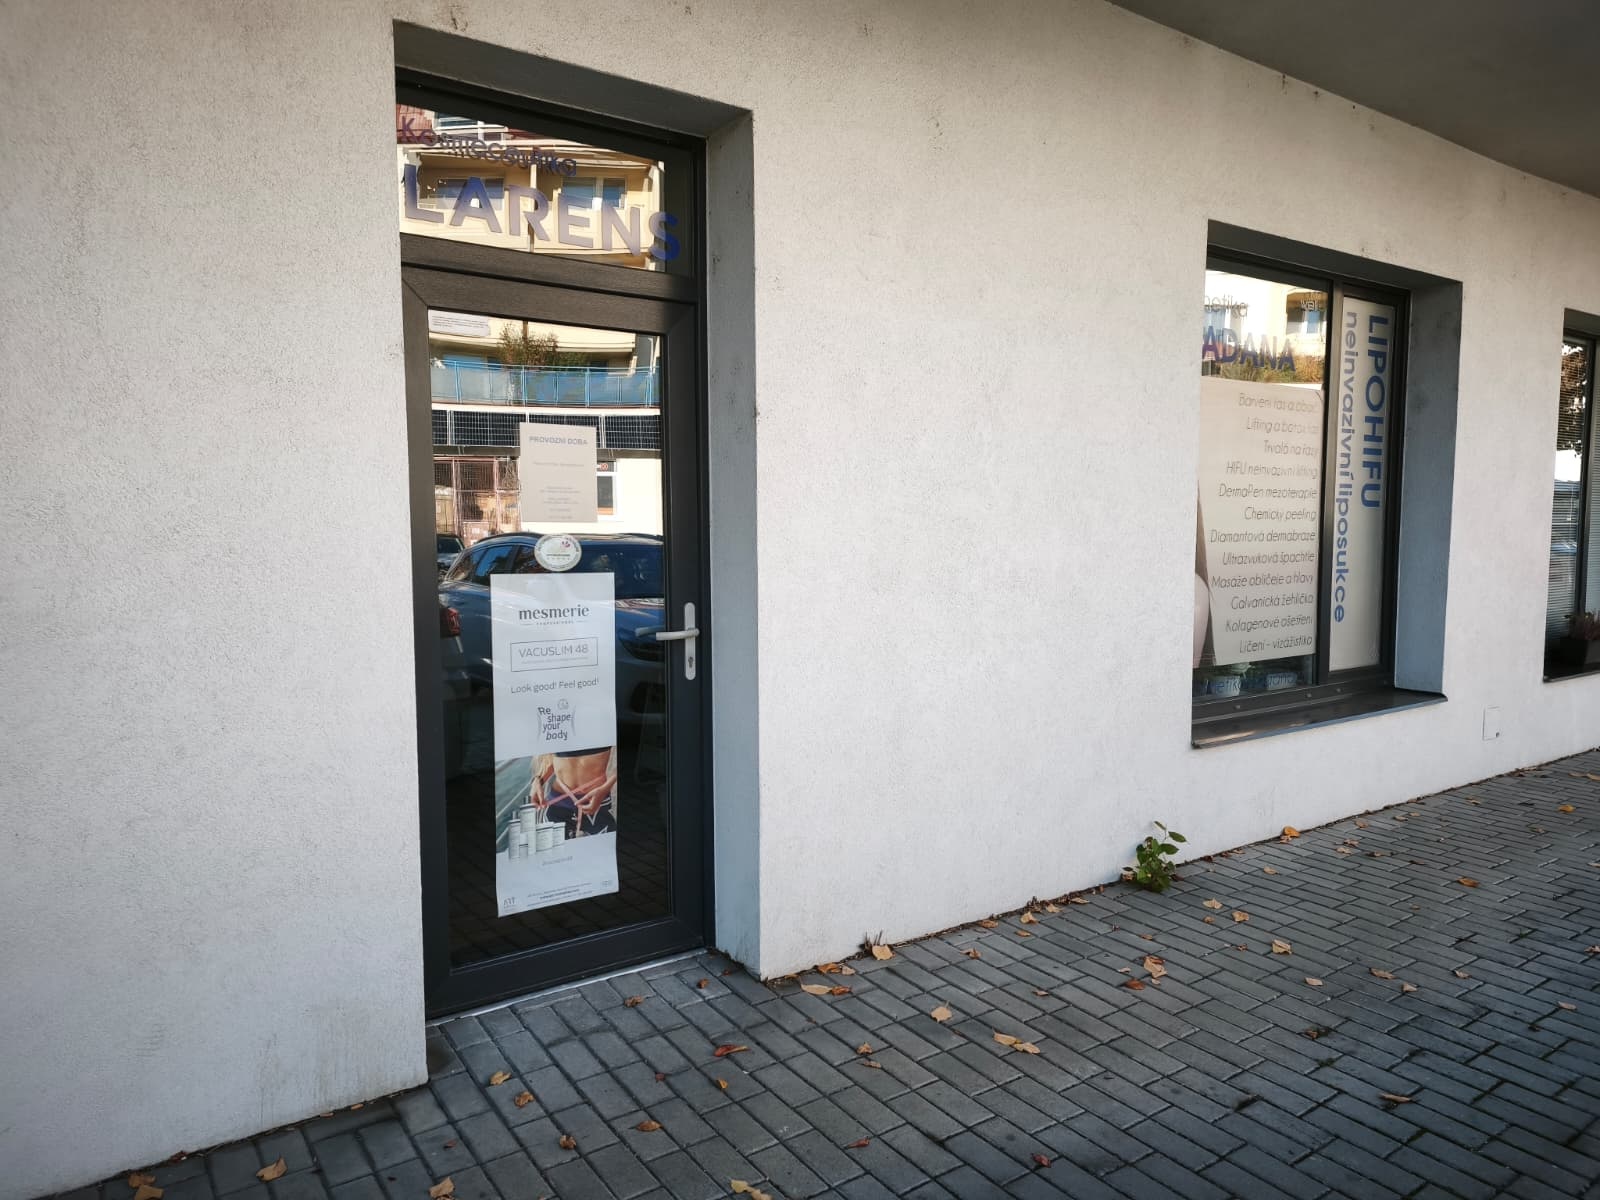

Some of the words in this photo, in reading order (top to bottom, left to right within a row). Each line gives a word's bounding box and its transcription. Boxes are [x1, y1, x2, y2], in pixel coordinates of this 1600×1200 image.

[403, 163, 681, 261] LARENS
[1339, 311, 1359, 480] neinvazivní
[1360, 314, 1389, 508] LIPOHIFU
[1285, 507, 1317, 522] peeling
[1334, 483, 1353, 623] liposukce
[518, 604, 590, 621] mesmerie
[519, 645, 573, 658] VACUSLIM
[575, 643, 589, 654] 48
[511, 683, 532, 694] Look
[559, 679, 576, 689] Feel
[537, 706, 551, 716] Re
[547, 712, 571, 724] shape
[542, 721, 561, 734] your
[545, 729, 568, 741] body
